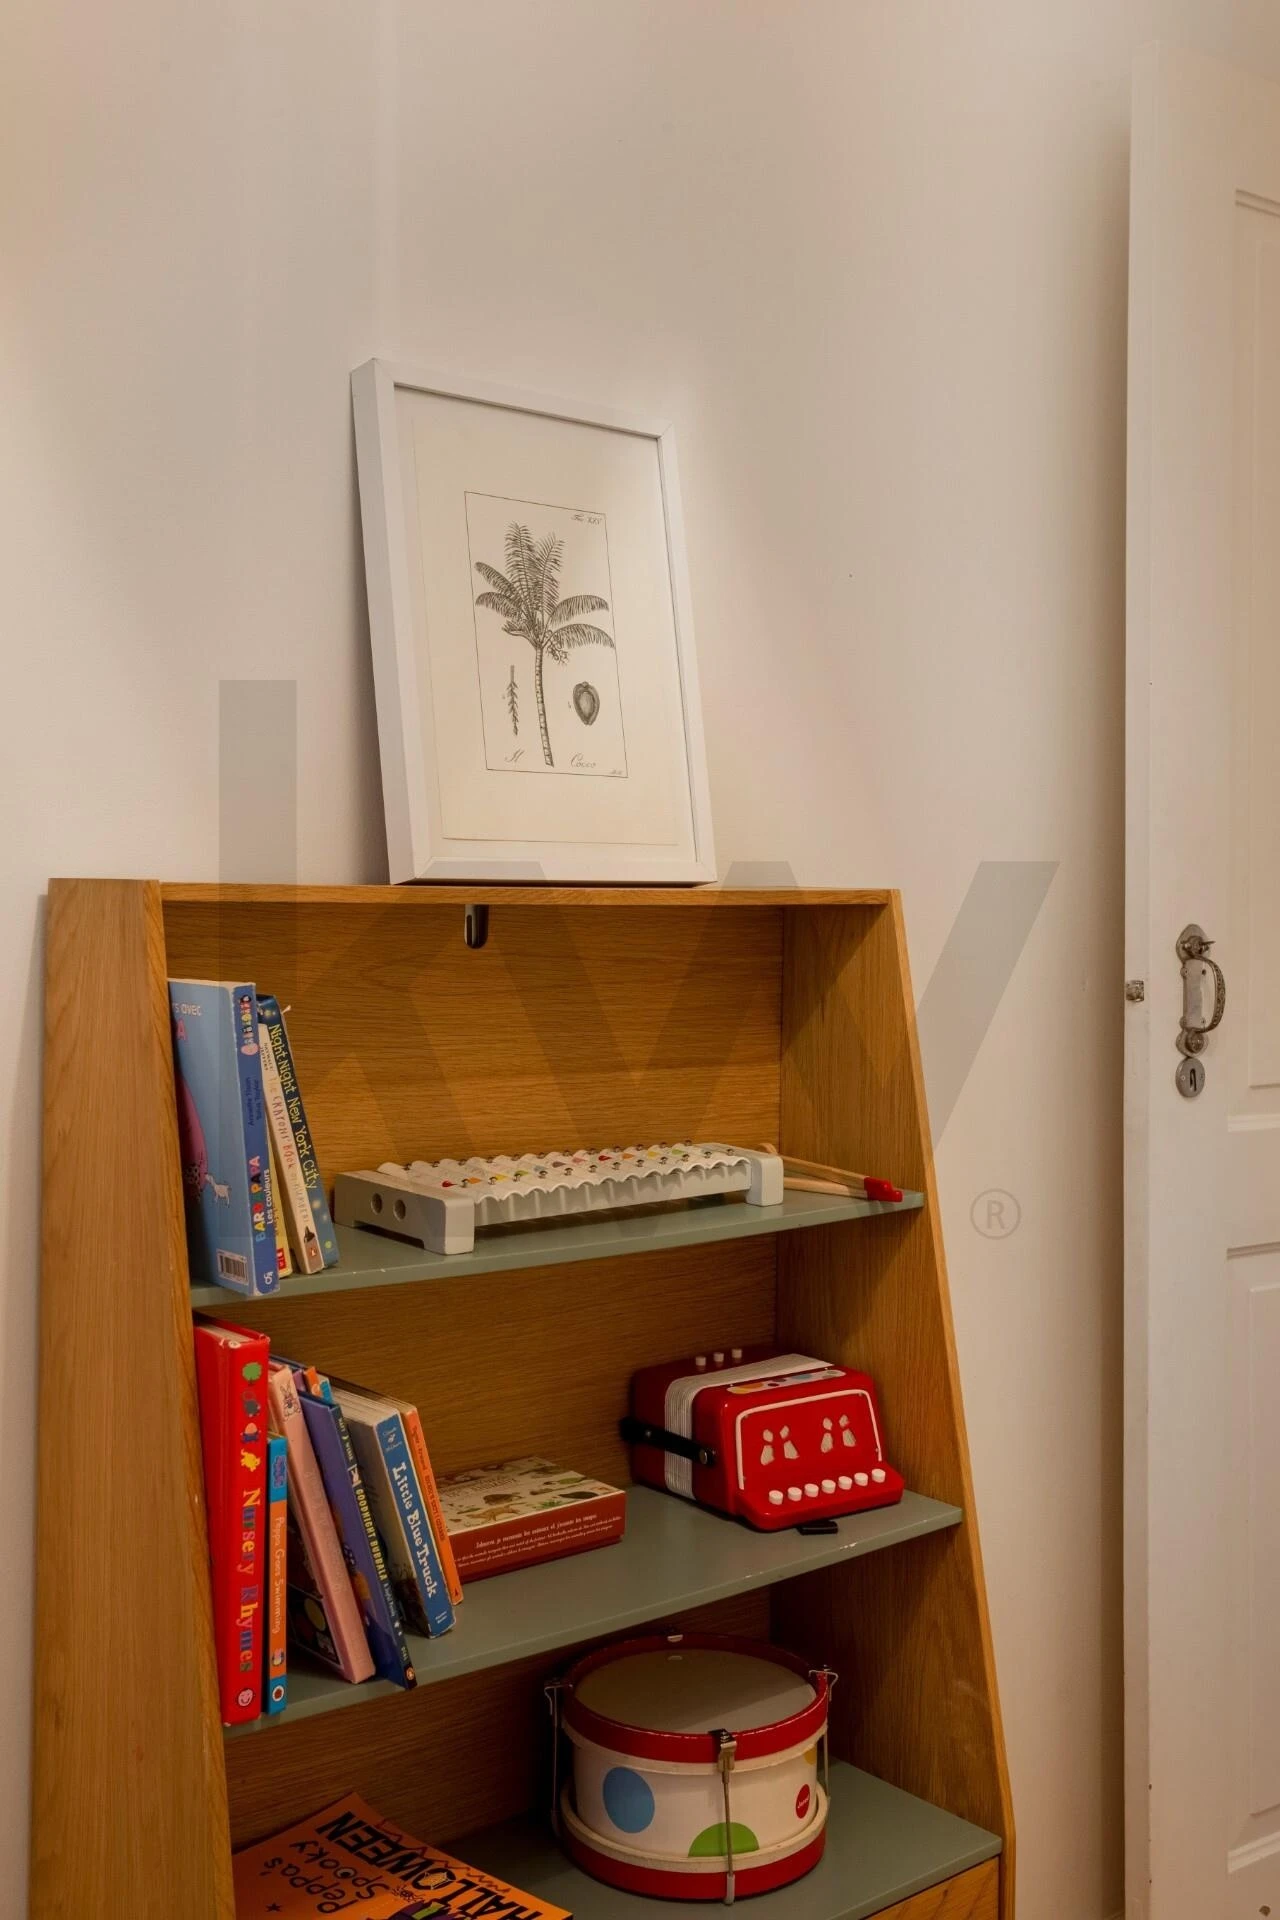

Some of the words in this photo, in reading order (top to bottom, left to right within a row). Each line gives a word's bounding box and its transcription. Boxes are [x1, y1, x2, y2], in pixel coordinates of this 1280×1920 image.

[287, 1097, 302, 1124] New
[295, 1125, 312, 1159] York
[264, 1169, 273, 1208] couleurs
[303, 1160, 320, 1189] City
[237, 1488, 260, 1576] Nursery
[356, 1488, 377, 1538] GOODNIGHT
[370, 1539, 388, 1580] BUBBALA
[392, 1462, 413, 1509] Little
[407, 1509, 423, 1547] Blue
[417, 1544, 438, 1598] Truck
[236, 1585, 259, 1672] Rhymes
[271, 1578, 284, 1633] Swimming
[259, 1857, 359, 1914] Peppa's
[289, 1840, 390, 1899] Spooky
